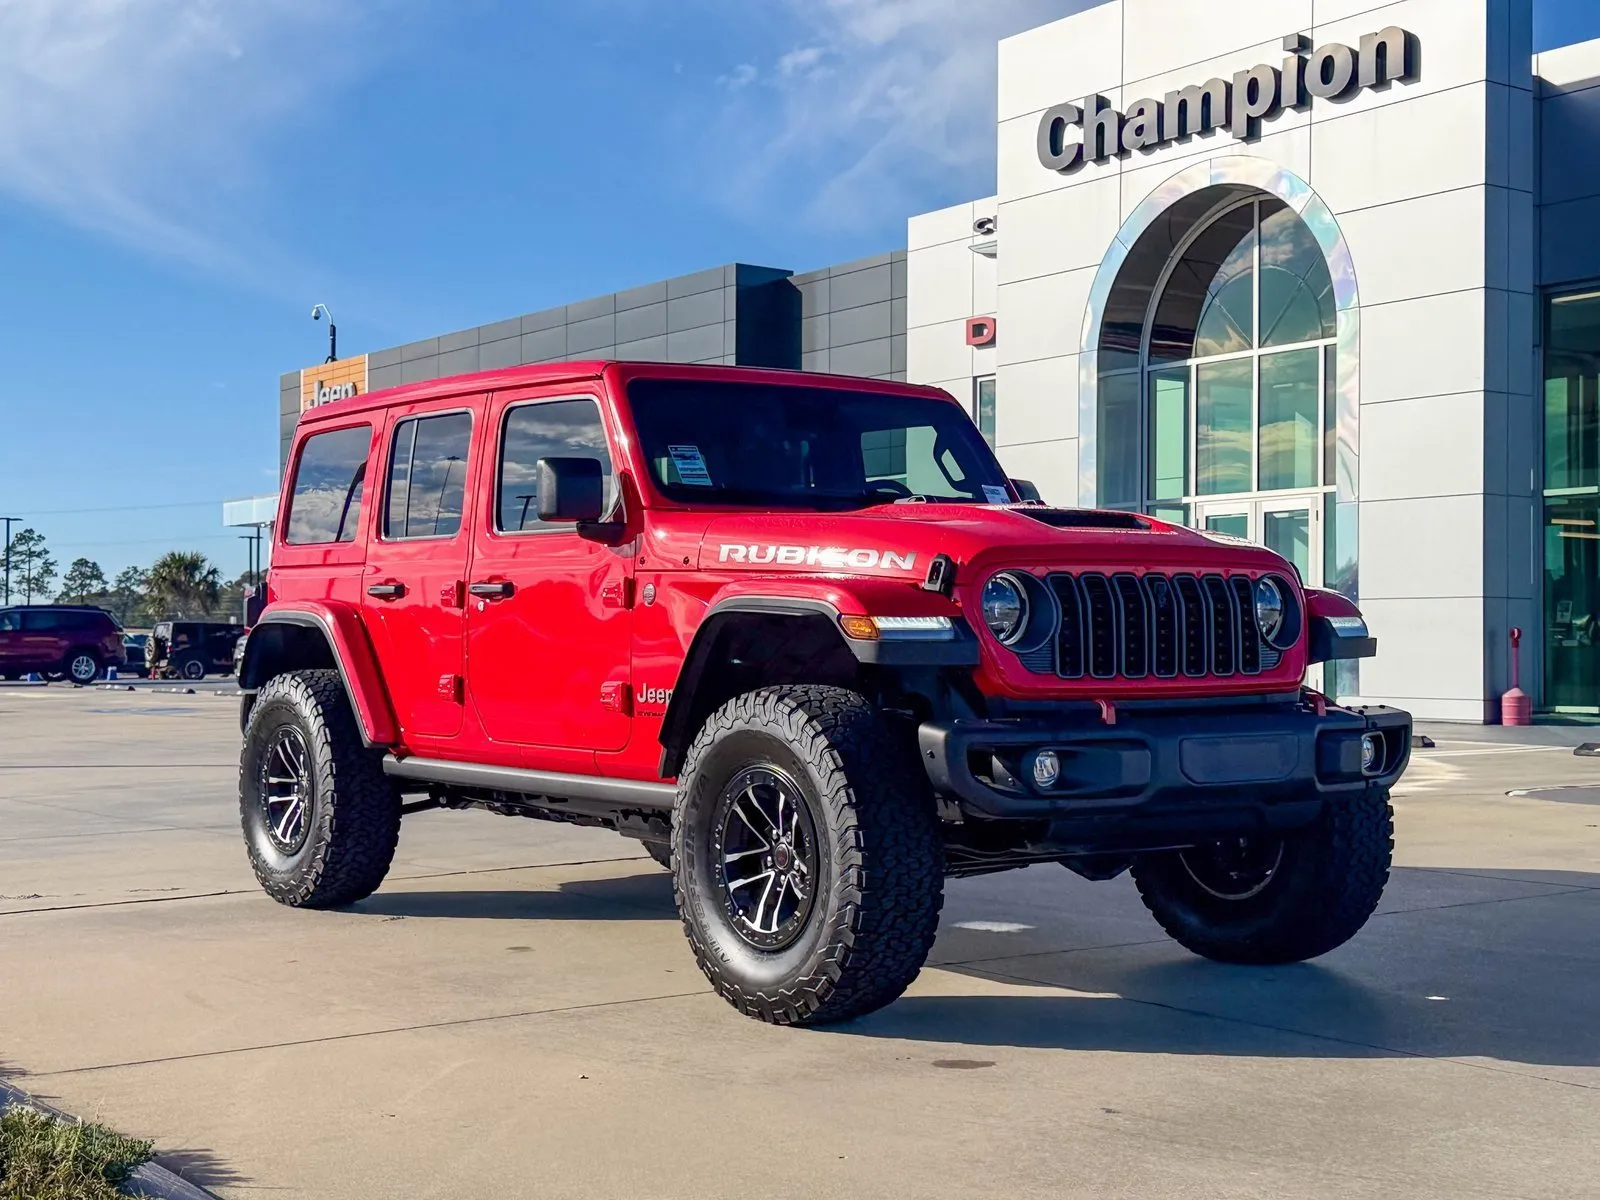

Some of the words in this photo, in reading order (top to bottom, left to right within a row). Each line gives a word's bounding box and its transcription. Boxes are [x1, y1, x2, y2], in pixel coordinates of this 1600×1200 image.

[1036, 25, 1420, 174] Champion
[973, 214, 997, 235] C
[718, 543, 918, 571] RUBICON
